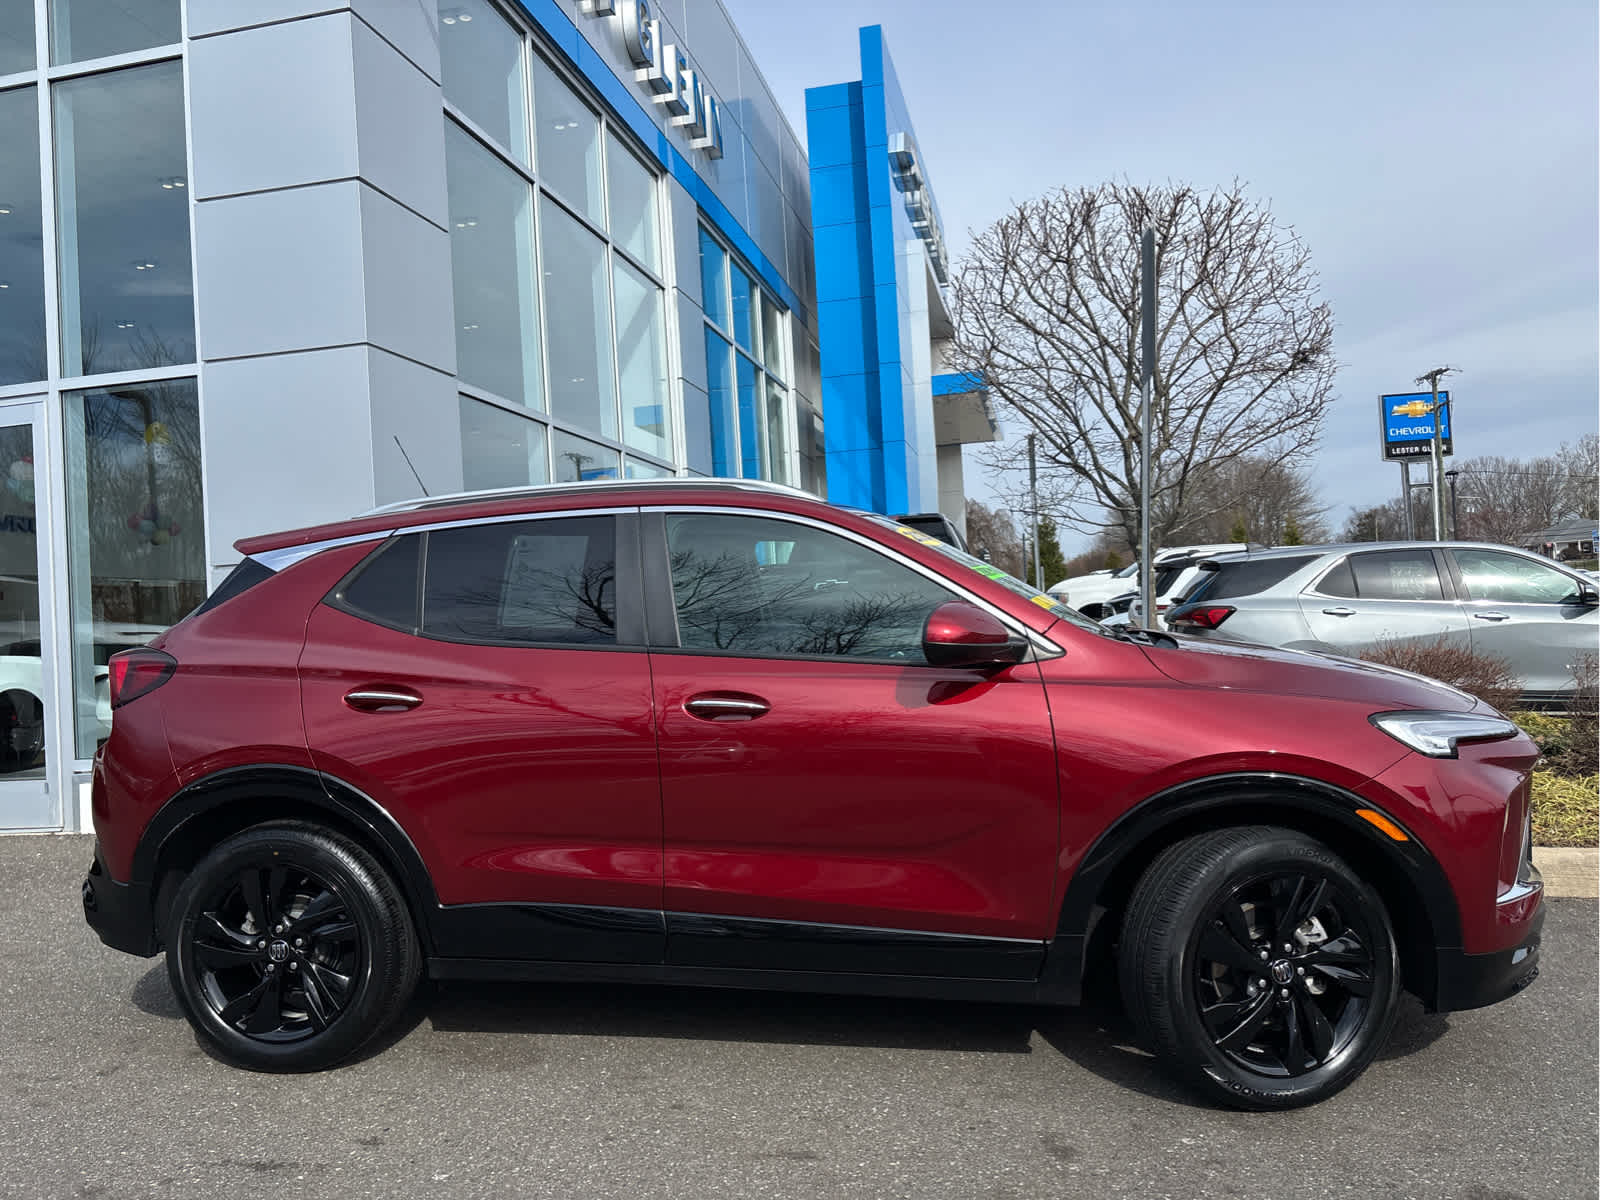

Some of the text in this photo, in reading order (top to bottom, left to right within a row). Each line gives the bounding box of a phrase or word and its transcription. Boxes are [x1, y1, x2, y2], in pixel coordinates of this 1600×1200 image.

[1390, 425, 1446, 436] CHEVROLT
[1391, 444, 1447, 454] LESTER GLN
